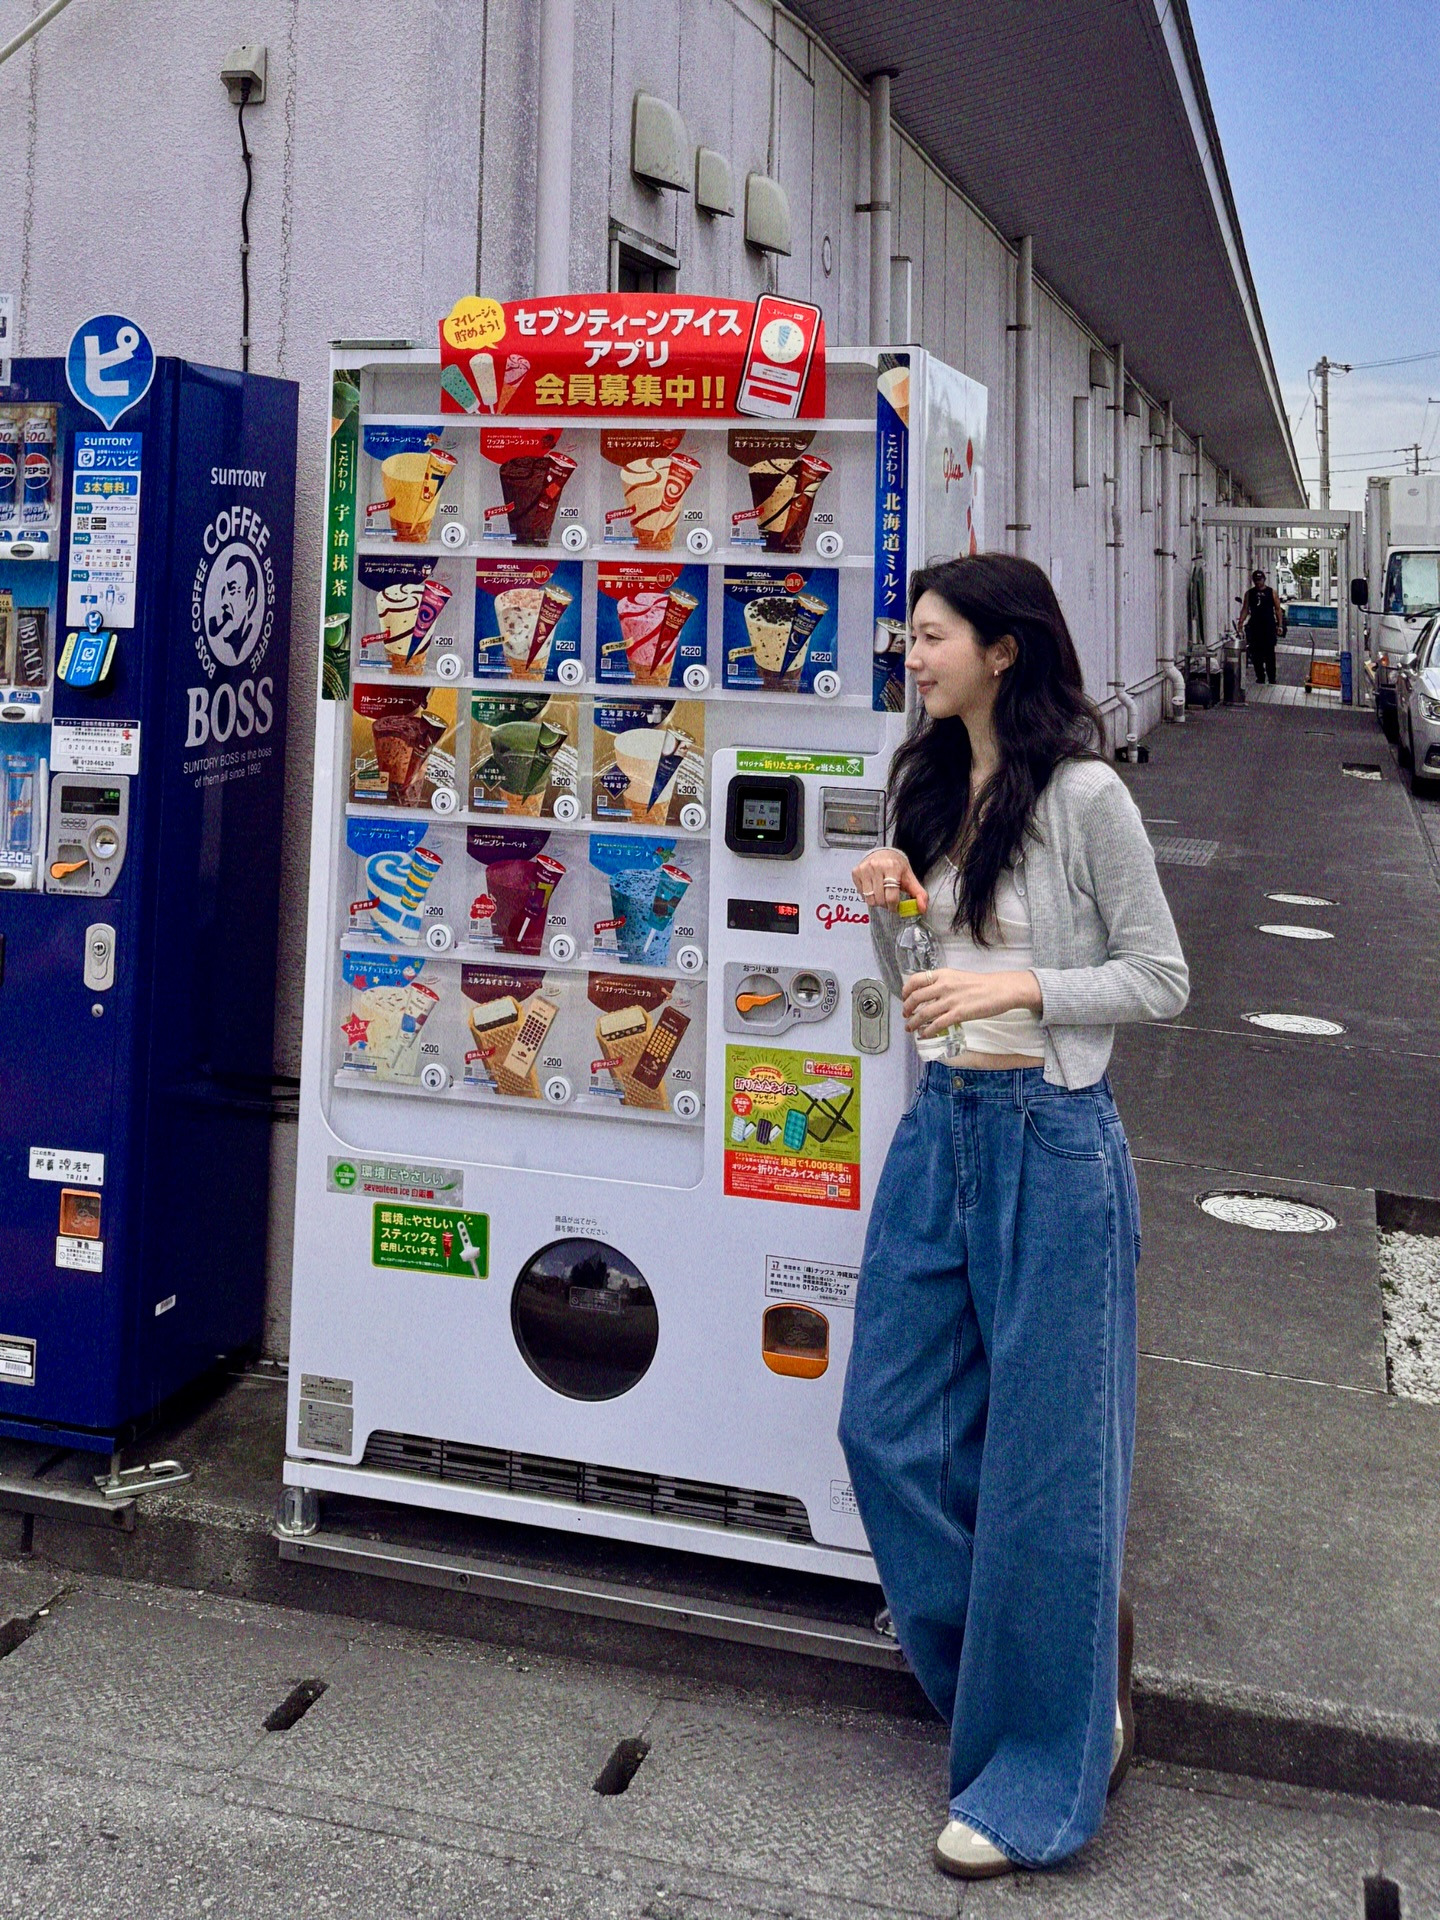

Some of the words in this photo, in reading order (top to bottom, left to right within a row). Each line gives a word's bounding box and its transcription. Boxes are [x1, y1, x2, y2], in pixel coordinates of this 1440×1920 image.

[451, 308, 498, 328] マイレージを
[514, 307, 743, 337] セブンティーンアイス
[454, 318, 501, 345] 貯めよう!
[583, 338, 669, 368] アプリ
[535, 373, 725, 409] 会員募集中!!
[84, 437, 133, 446] SUNTORY
[96, 455, 138, 466] ジハンピ
[338, 443, 347, 492] こだわり
[886, 433, 899, 487] こだわり
[211, 467, 266, 488] SUNTORY
[84, 482, 129, 493] 3本無料!
[204, 506, 270, 555] COFFEE
[332, 504, 350, 597] 宇治抹茶
[882, 493, 901, 606] 北海道ミルク
[731, 586, 787, 594] クッキー&クリーム
[20, 623, 44, 682] BLACK
[184, 677, 274, 747] BOSS
[600, 709, 646, 718] 北海道ミルク
[354, 831, 405, 840] ソーダフロート
[597, 847, 650, 857] チョコミント
[825, 886, 857, 894] すこやかな
[828, 894, 865, 902] ゆたかな人
[816, 903, 870, 930] Glico
[468, 977, 521, 988] ミルクあずきモナカ
[734, 1078, 798, 1095] 折りたたみイス
[361, 1165, 444, 1185] 環境にやさしい
[363, 1183, 398, 1194] seventeen
[380, 1211, 453, 1229] 環境にやさしい
[381, 1227, 437, 1245] スティックを
[380, 1242, 439, 1257] 使用しています。
